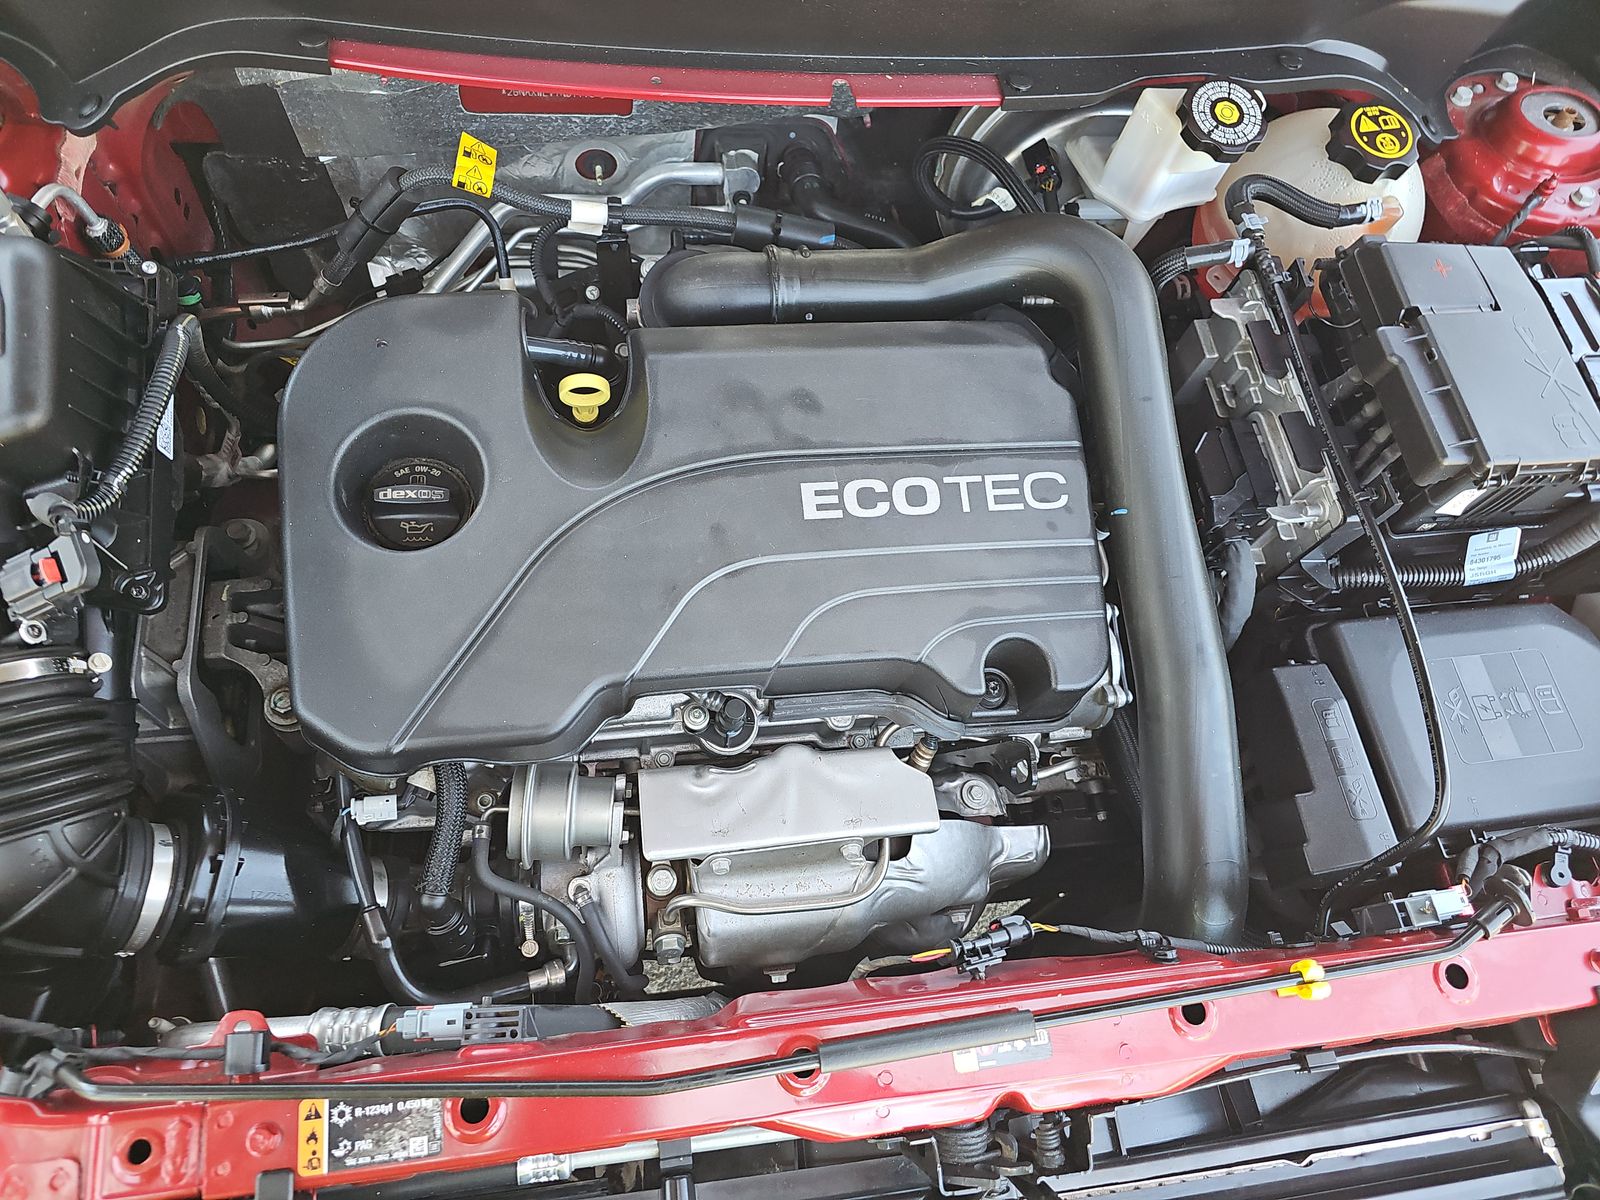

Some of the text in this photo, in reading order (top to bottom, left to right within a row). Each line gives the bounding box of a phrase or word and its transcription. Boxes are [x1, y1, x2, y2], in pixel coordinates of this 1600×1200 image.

[393, 465, 442, 478] SAE 0W-20
[378, 488, 445, 501] dexos
[800, 471, 1069, 520] ECOTEC
